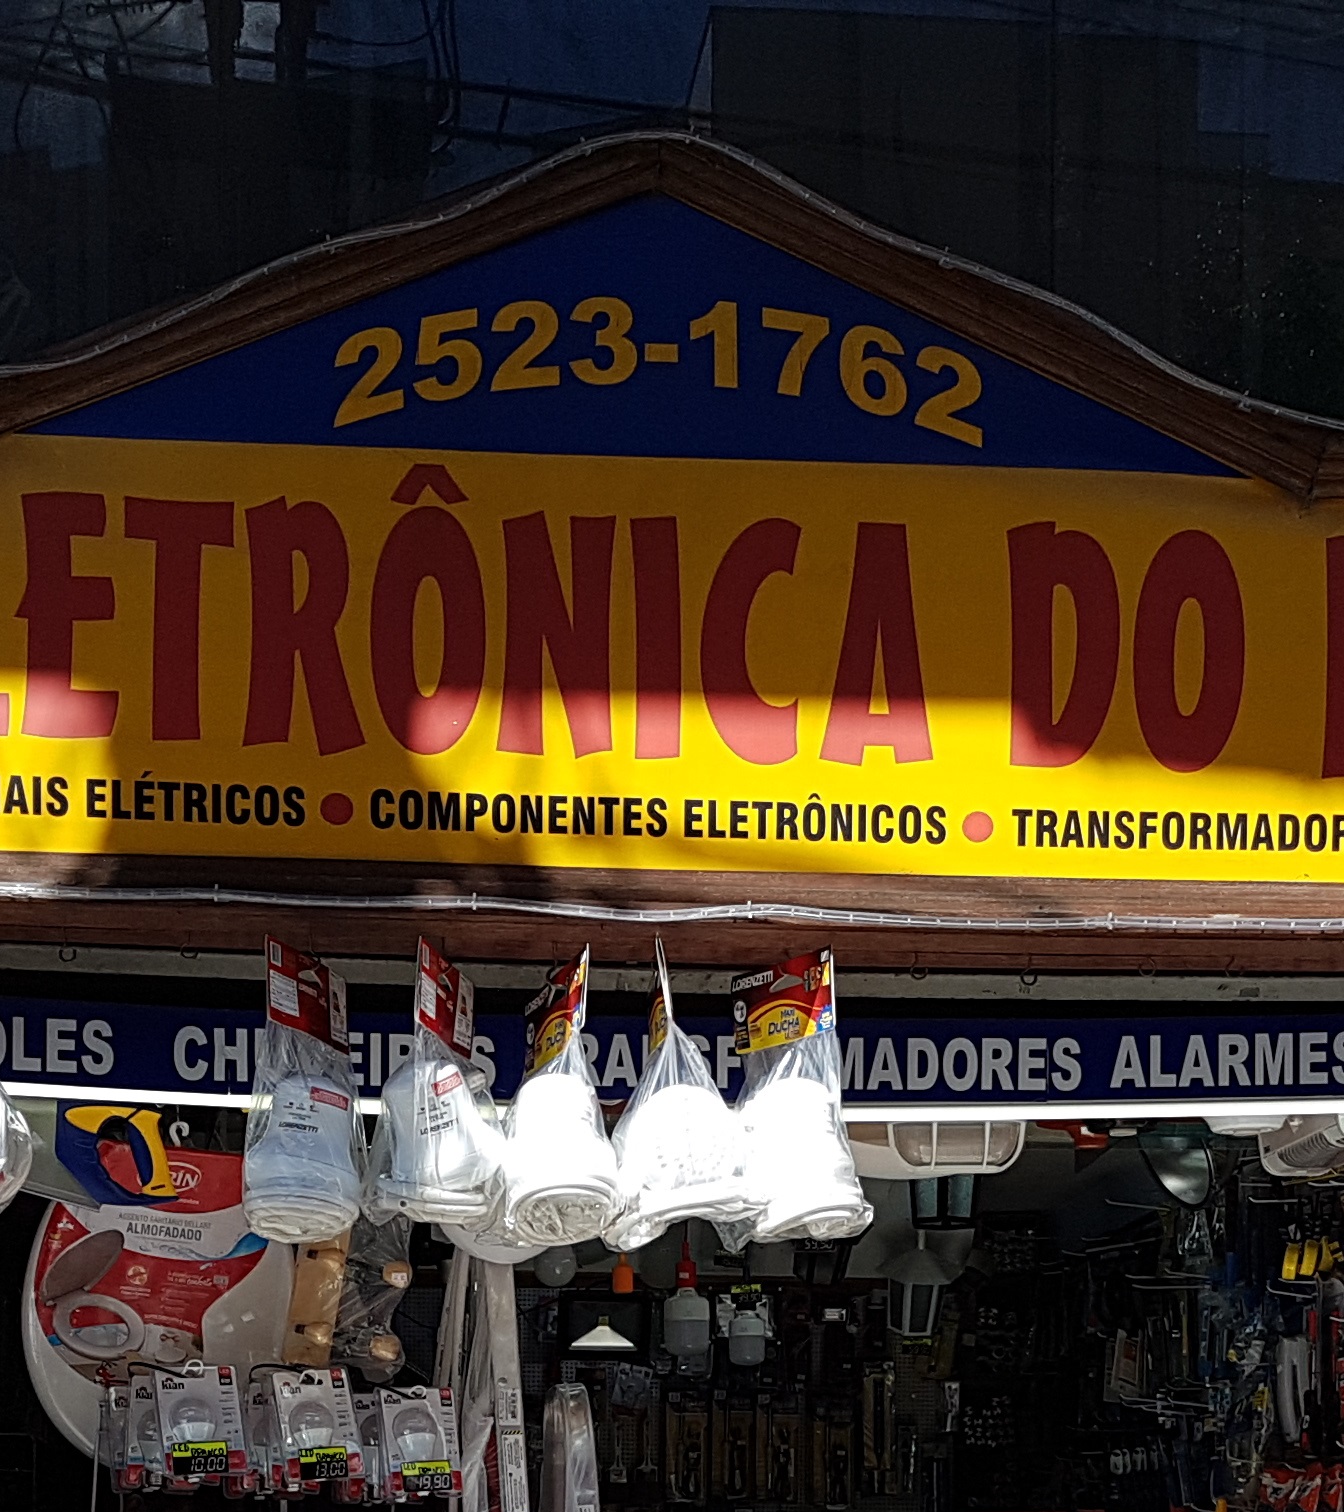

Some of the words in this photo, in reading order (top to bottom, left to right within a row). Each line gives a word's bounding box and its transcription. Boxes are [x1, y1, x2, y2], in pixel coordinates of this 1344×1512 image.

[333, 296, 983, 448] 2523-1762
[1008, 519, 1247, 773] DO
[86, 766, 306, 829] ELÉTRICOS
[369, 793, 668, 840] COMPONENTES
[683, 794, 947, 846] ELETRÔNICOS
[126, 1222, 203, 1242] ALMOFADADO
